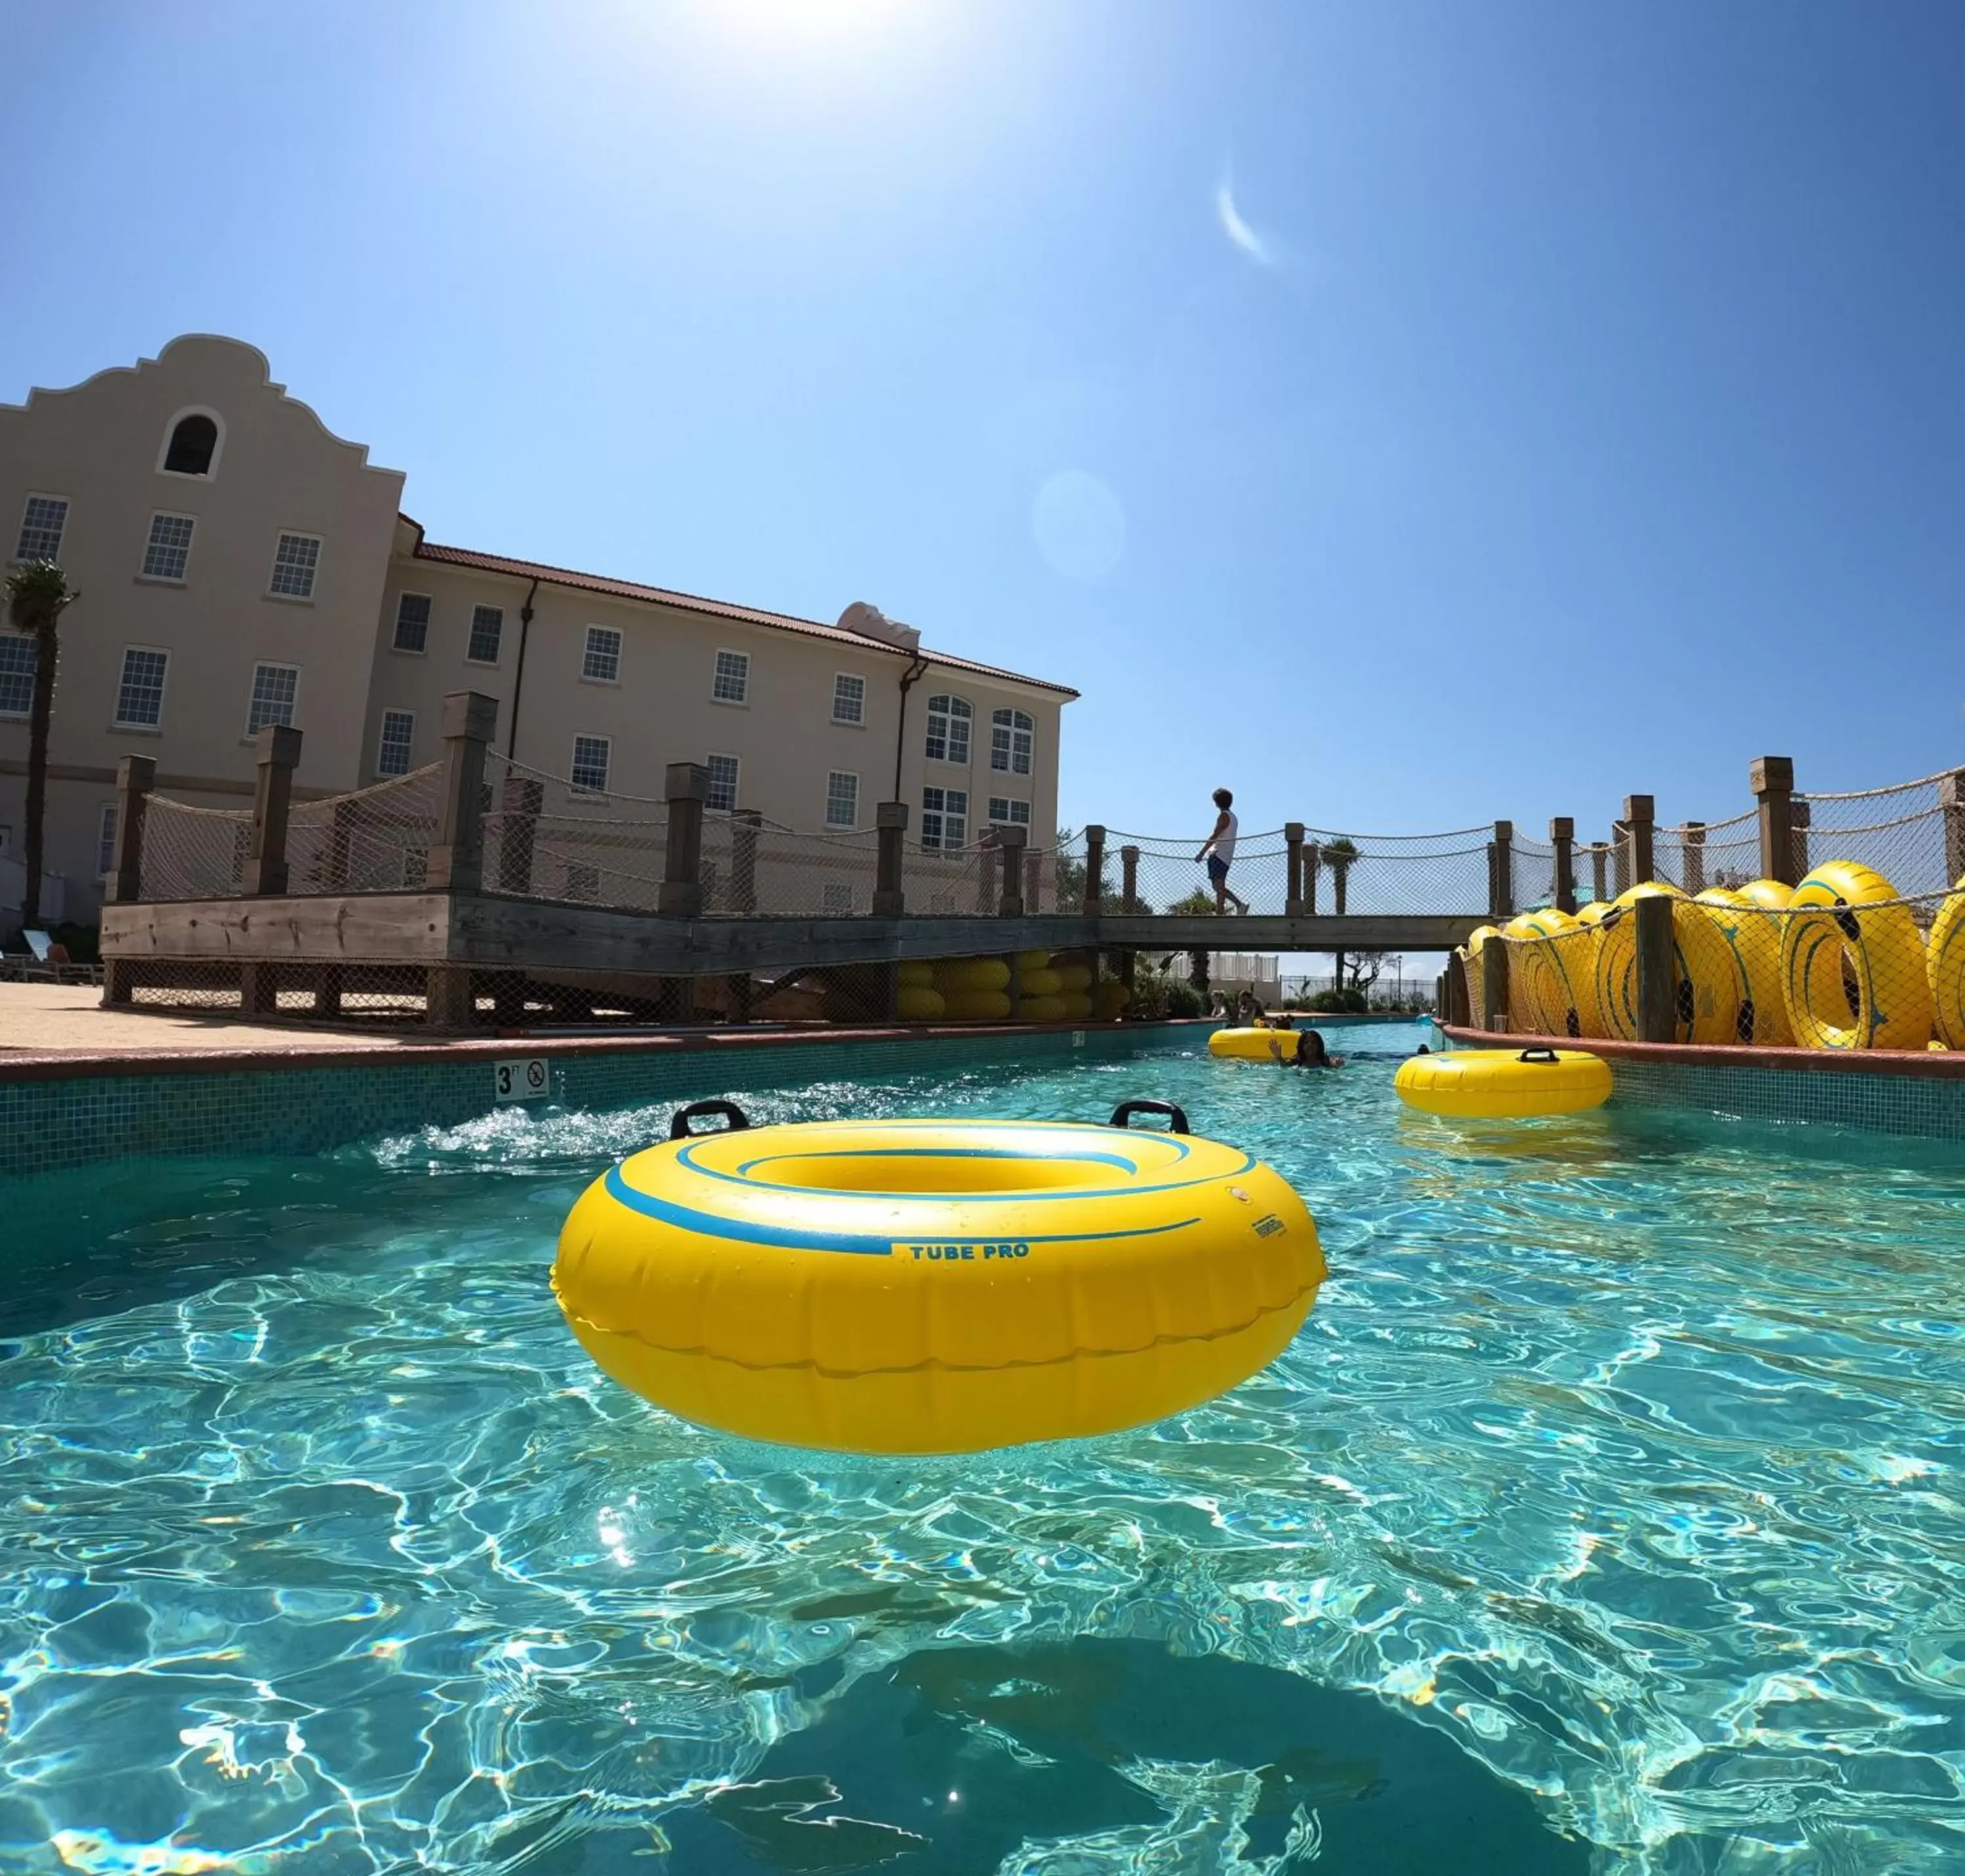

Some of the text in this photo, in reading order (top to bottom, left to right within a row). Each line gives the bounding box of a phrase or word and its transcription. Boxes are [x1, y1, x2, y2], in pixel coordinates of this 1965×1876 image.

[498, 1065, 519, 1094] 3 FT
[910, 1243, 1029, 1260] TUBE PRO
